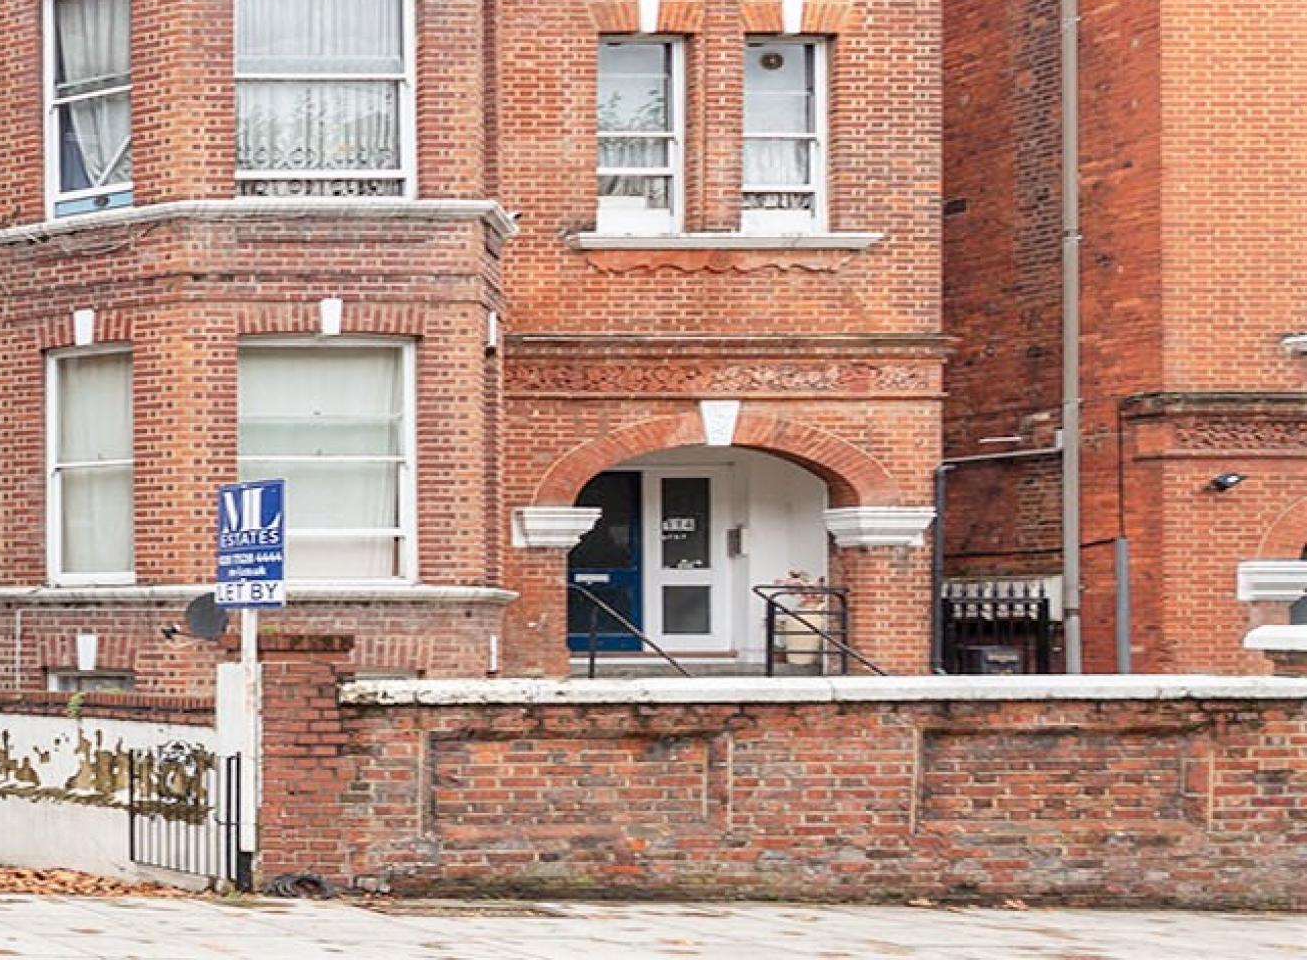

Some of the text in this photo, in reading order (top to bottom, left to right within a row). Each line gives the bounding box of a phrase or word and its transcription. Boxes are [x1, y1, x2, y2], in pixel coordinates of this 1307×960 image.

[222, 487, 281, 533] ML
[221, 531, 279, 548] ESTATES
[217, 583, 277, 601] LET BY
